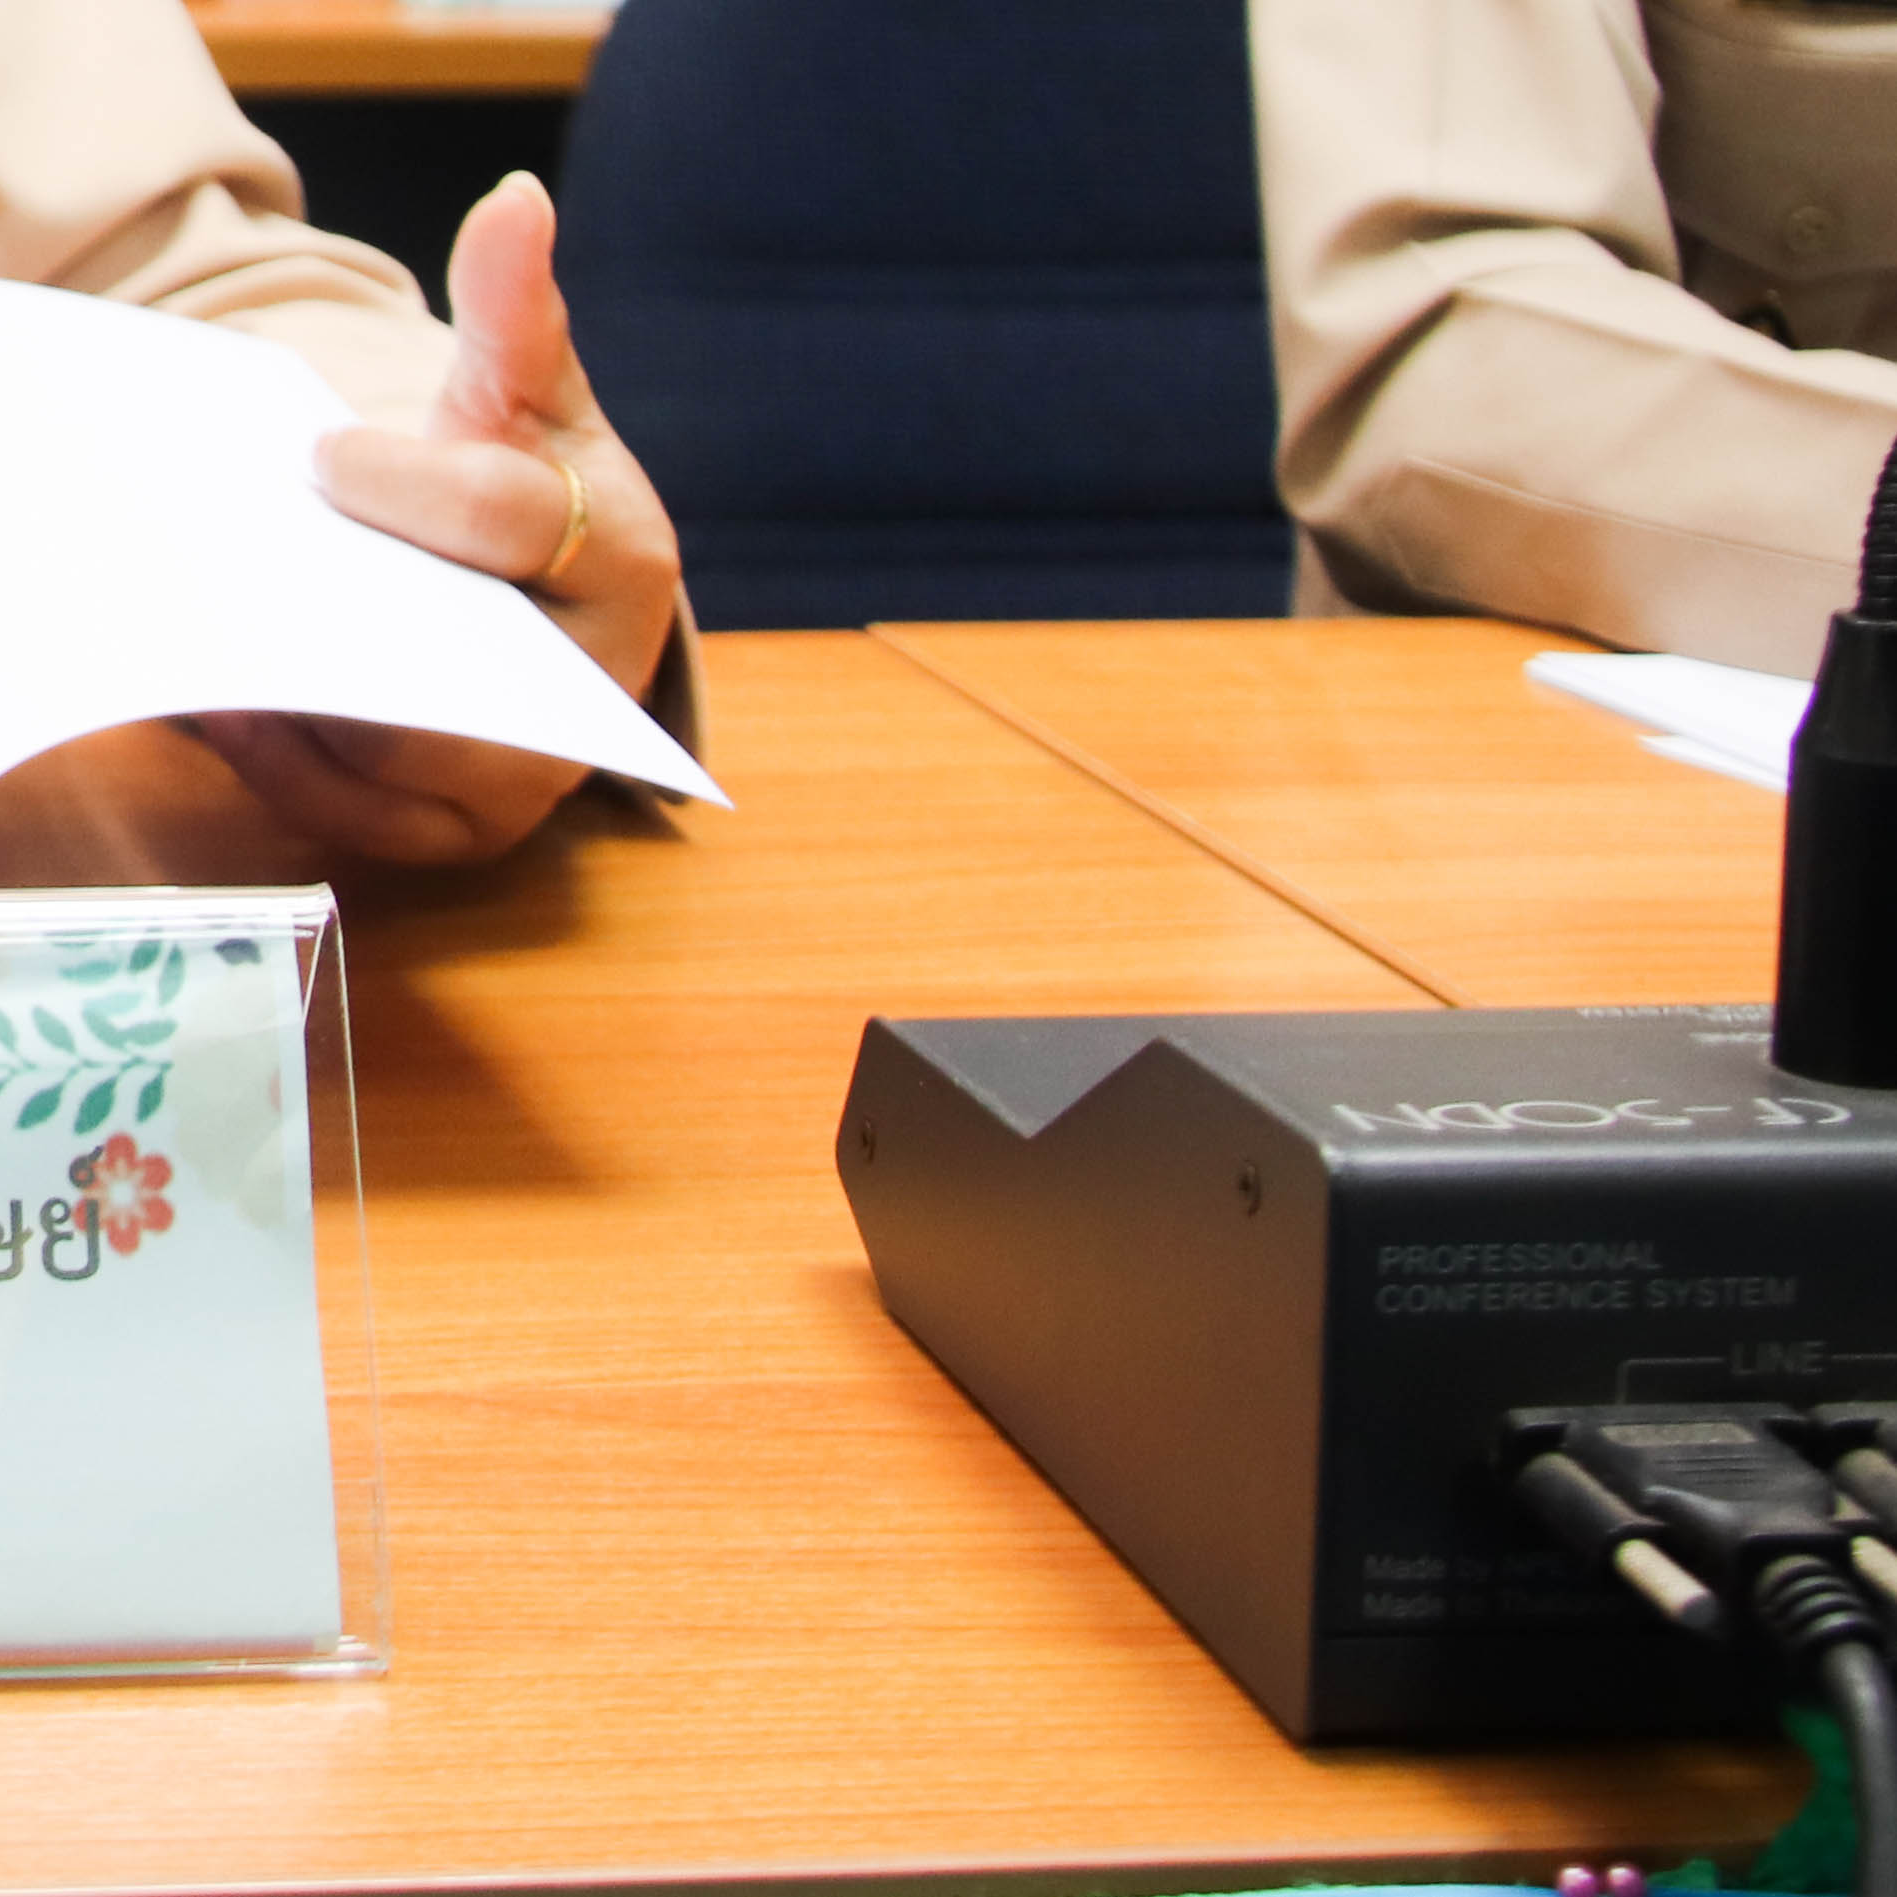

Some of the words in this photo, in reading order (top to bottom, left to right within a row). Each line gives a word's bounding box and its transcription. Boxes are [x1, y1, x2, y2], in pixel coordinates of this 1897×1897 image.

[1377, 1241, 1664, 1276] PROFESSIONAL
[1375, 1279, 1633, 1314] CONFERENCE
[1644, 1274, 1799, 1307] SYSTEM
[1729, 1340, 1827, 1376] LINE
